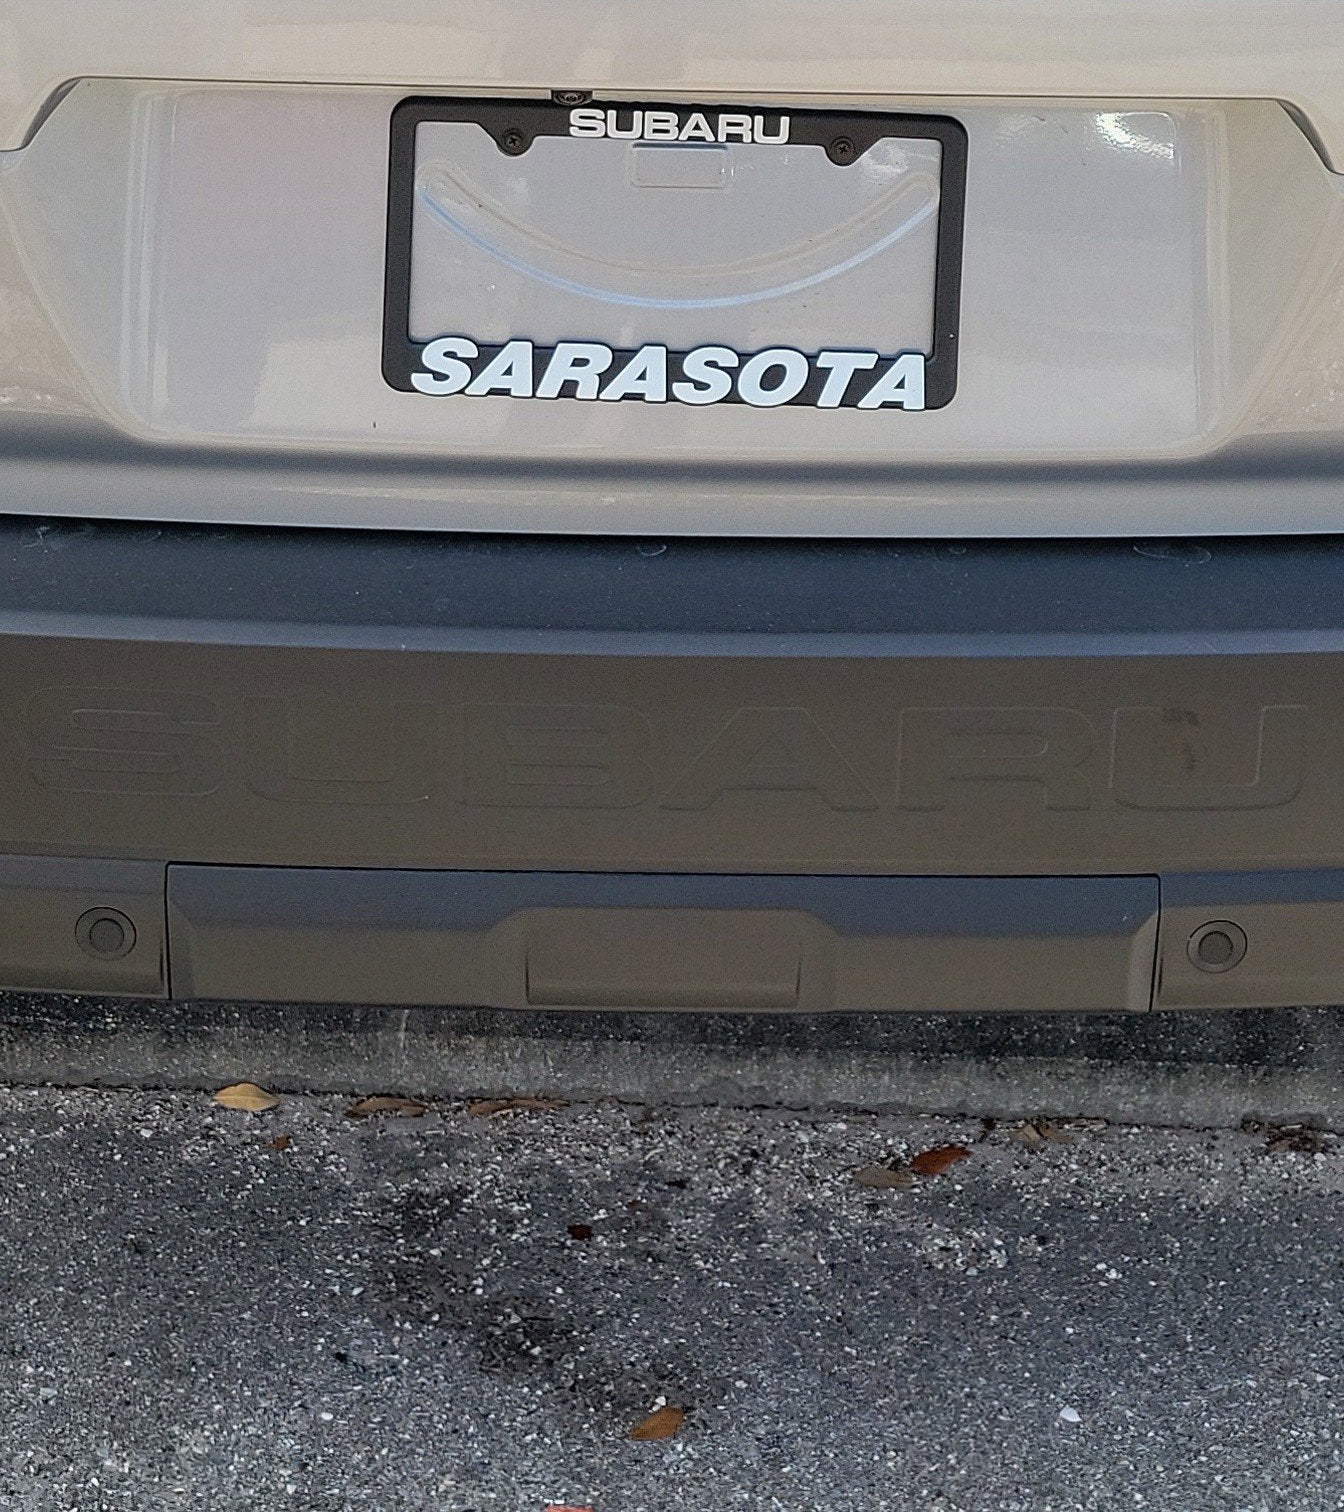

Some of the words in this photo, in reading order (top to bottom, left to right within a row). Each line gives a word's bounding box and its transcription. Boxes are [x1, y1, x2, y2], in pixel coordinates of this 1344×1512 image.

[569, 108, 790, 145] SUBARU
[410, 337, 927, 411] SARASOTA
[24, 686, 1309, 812] SUBARU
